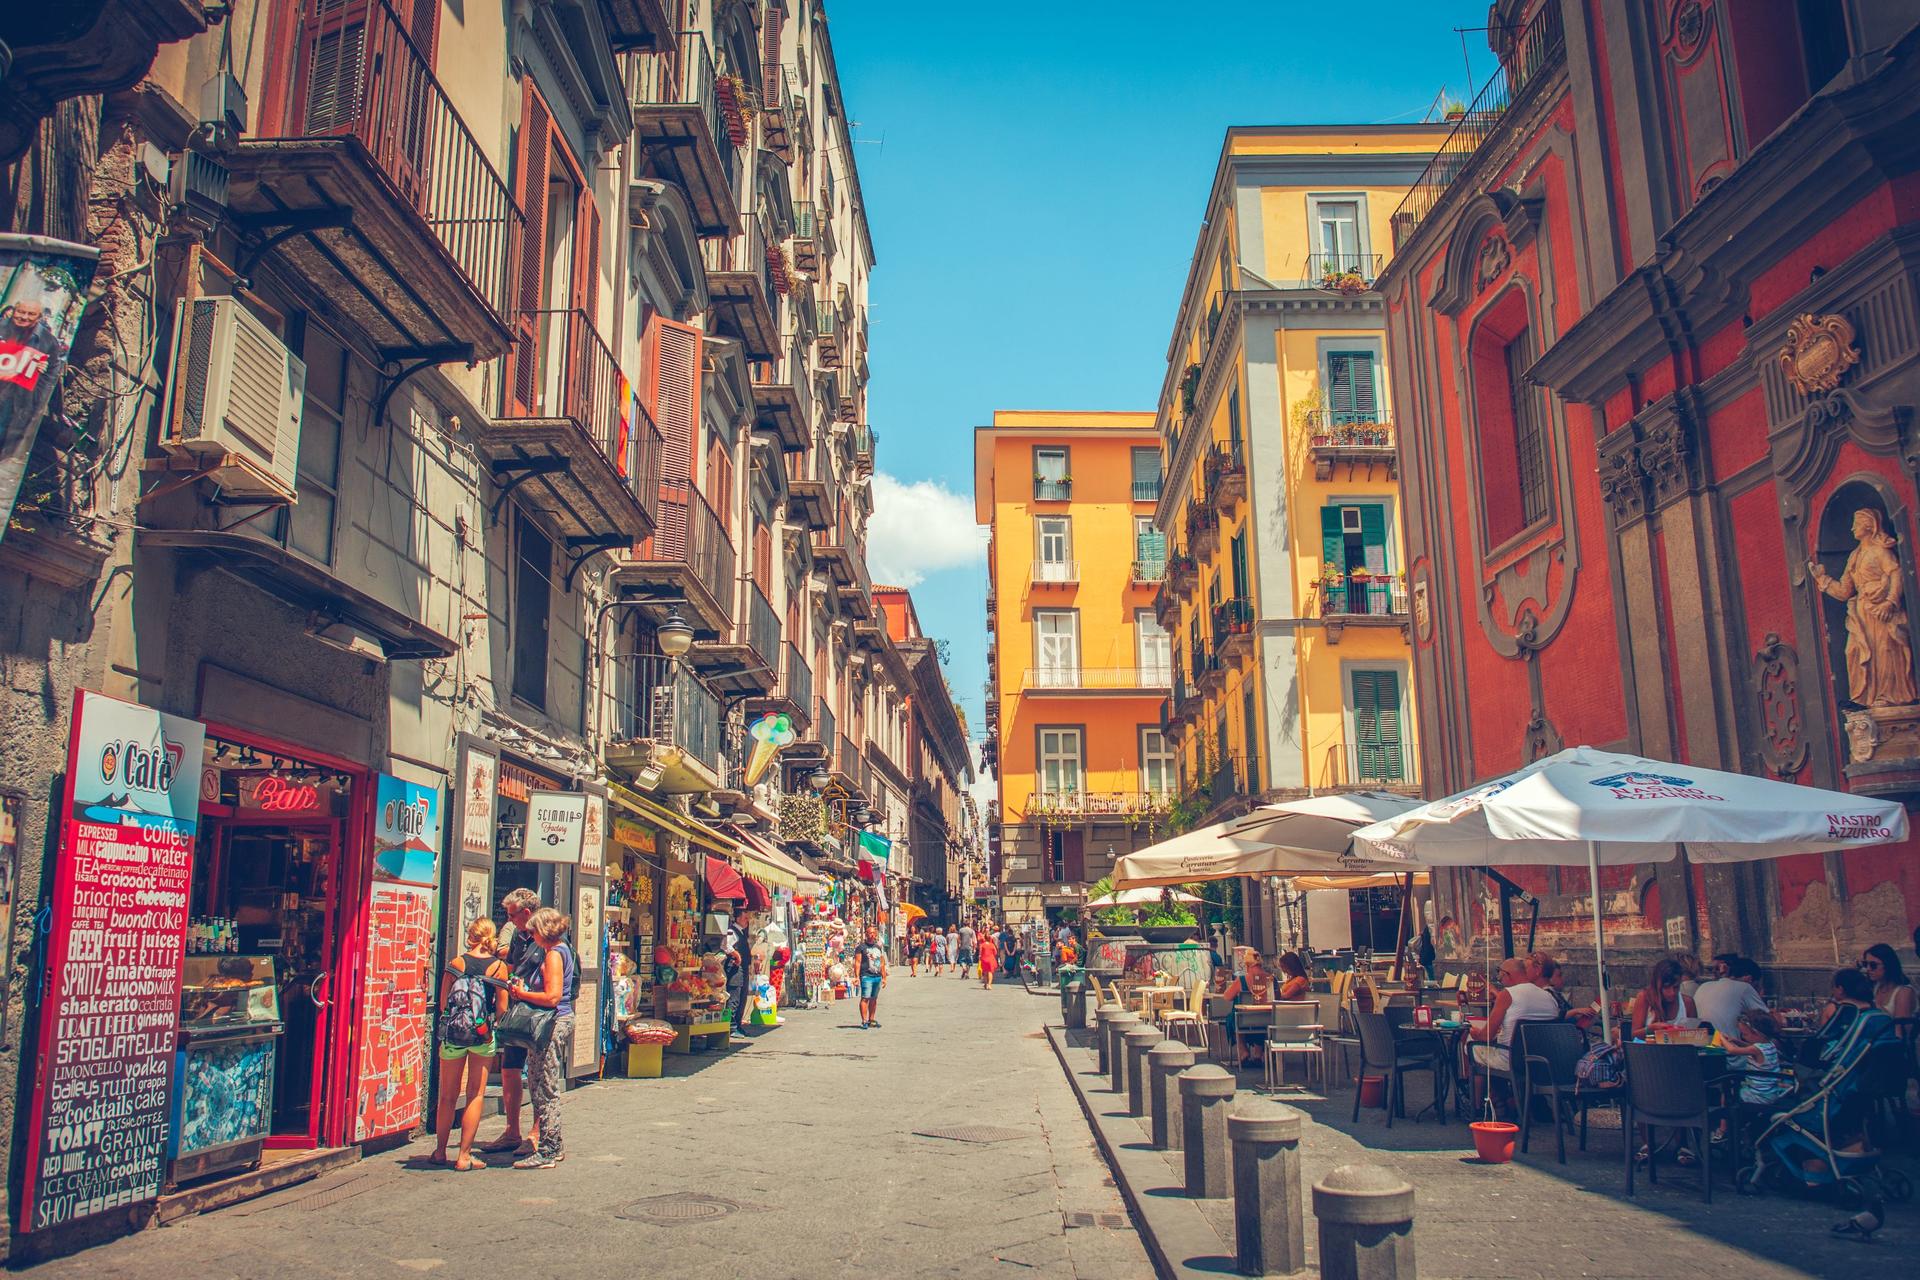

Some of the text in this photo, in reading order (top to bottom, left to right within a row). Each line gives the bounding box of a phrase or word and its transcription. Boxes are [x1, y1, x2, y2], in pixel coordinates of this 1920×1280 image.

[252, 776, 316, 810] Bar
[1609, 785, 1704, 794] NASTRO
[1615, 791, 1725, 801] AZZURRO
[538, 808, 582, 823] SCIMMIA
[1826, 814, 1881, 827] NASTRO
[78, 827, 118, 841] EXPRESSED
[143, 820, 189, 847] coffee
[1828, 825, 1890, 839] AZZURRO
[74, 857, 100, 875] TEA
[76, 840, 188, 867] MILK cappuccino water
[75, 872, 185, 890] tisana croissant MILK
[73, 884, 134, 908] brioches
[152, 907, 182, 930] coke
[67, 929, 104, 961] BEER
[103, 928, 138, 948] fruit
[139, 930, 180, 951] juices
[103, 948, 178, 966] APERITIF
[62, 962, 104, 996] SPRITZ
[105, 964, 151, 980] amaro
[60, 994, 139, 1016] shakerato
[57, 1012, 175, 1040] DRAFT BEER ginseng
[57, 1031, 173, 1064] SFOGLIATELLE
[54, 1055, 167, 1081] LIMONCELLO vodka
[101, 1077, 137, 1098] rum
[138, 1077, 167, 1093] grappa
[48, 1086, 166, 1127] TEA cocktails cake
[48, 1121, 104, 1153] TOAST
[100, 1123, 169, 1154] GRANITE
[42, 1155, 62, 1179] RED
[88, 1150, 122, 1171] LONG
[42, 1157, 159, 1197] ICE CREAM cookies
[38, 1168, 162, 1228] SHOT WHITE WINE
